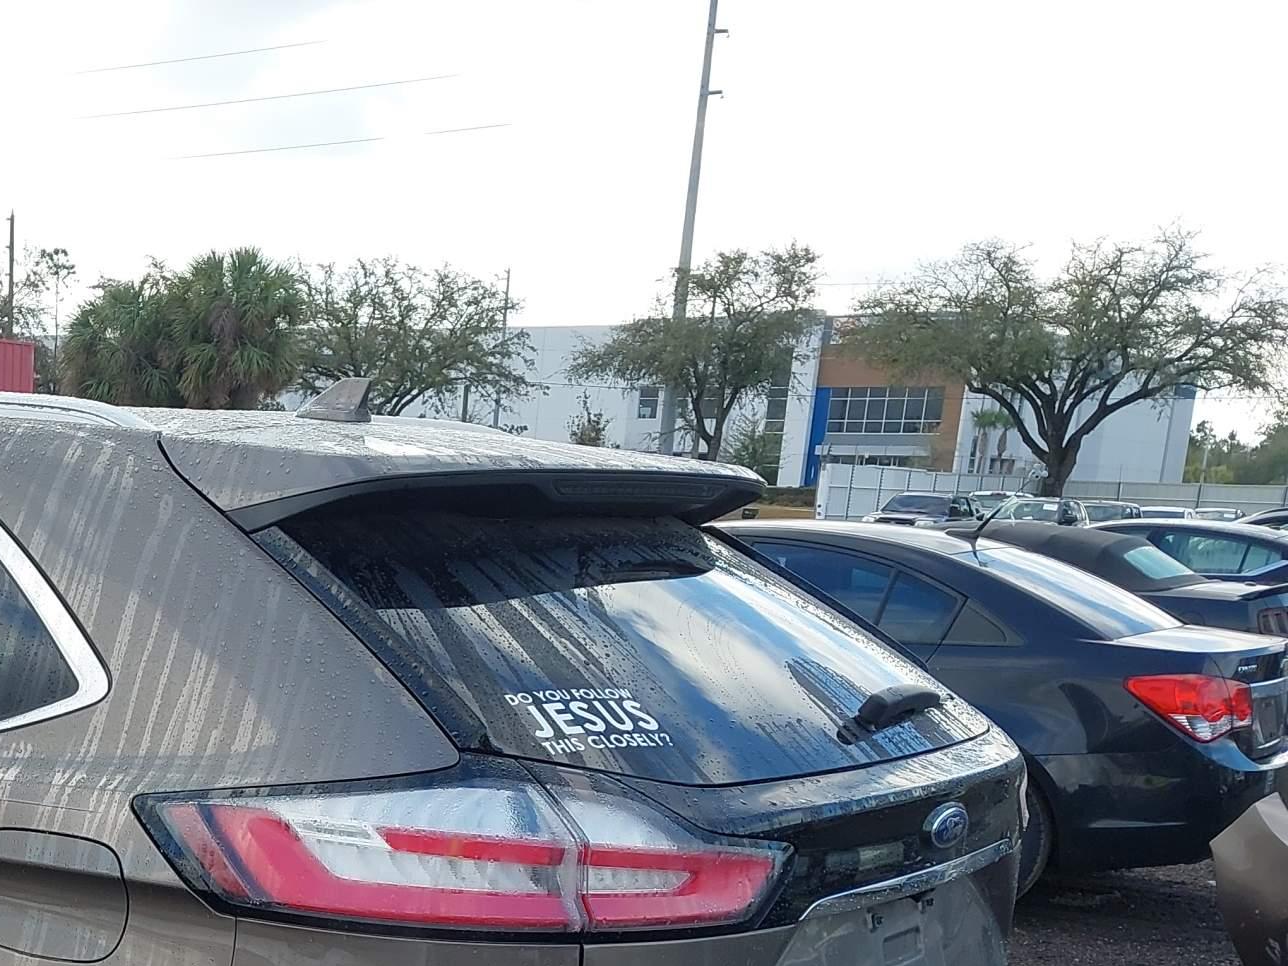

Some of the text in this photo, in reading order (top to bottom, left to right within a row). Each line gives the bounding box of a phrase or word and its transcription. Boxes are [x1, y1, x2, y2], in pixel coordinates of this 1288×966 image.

[504, 688, 633, 706] DO YOU FOLLOW
[527, 700, 660, 738] JESUS
[541, 732, 675, 756] THIS CLOSELY?
